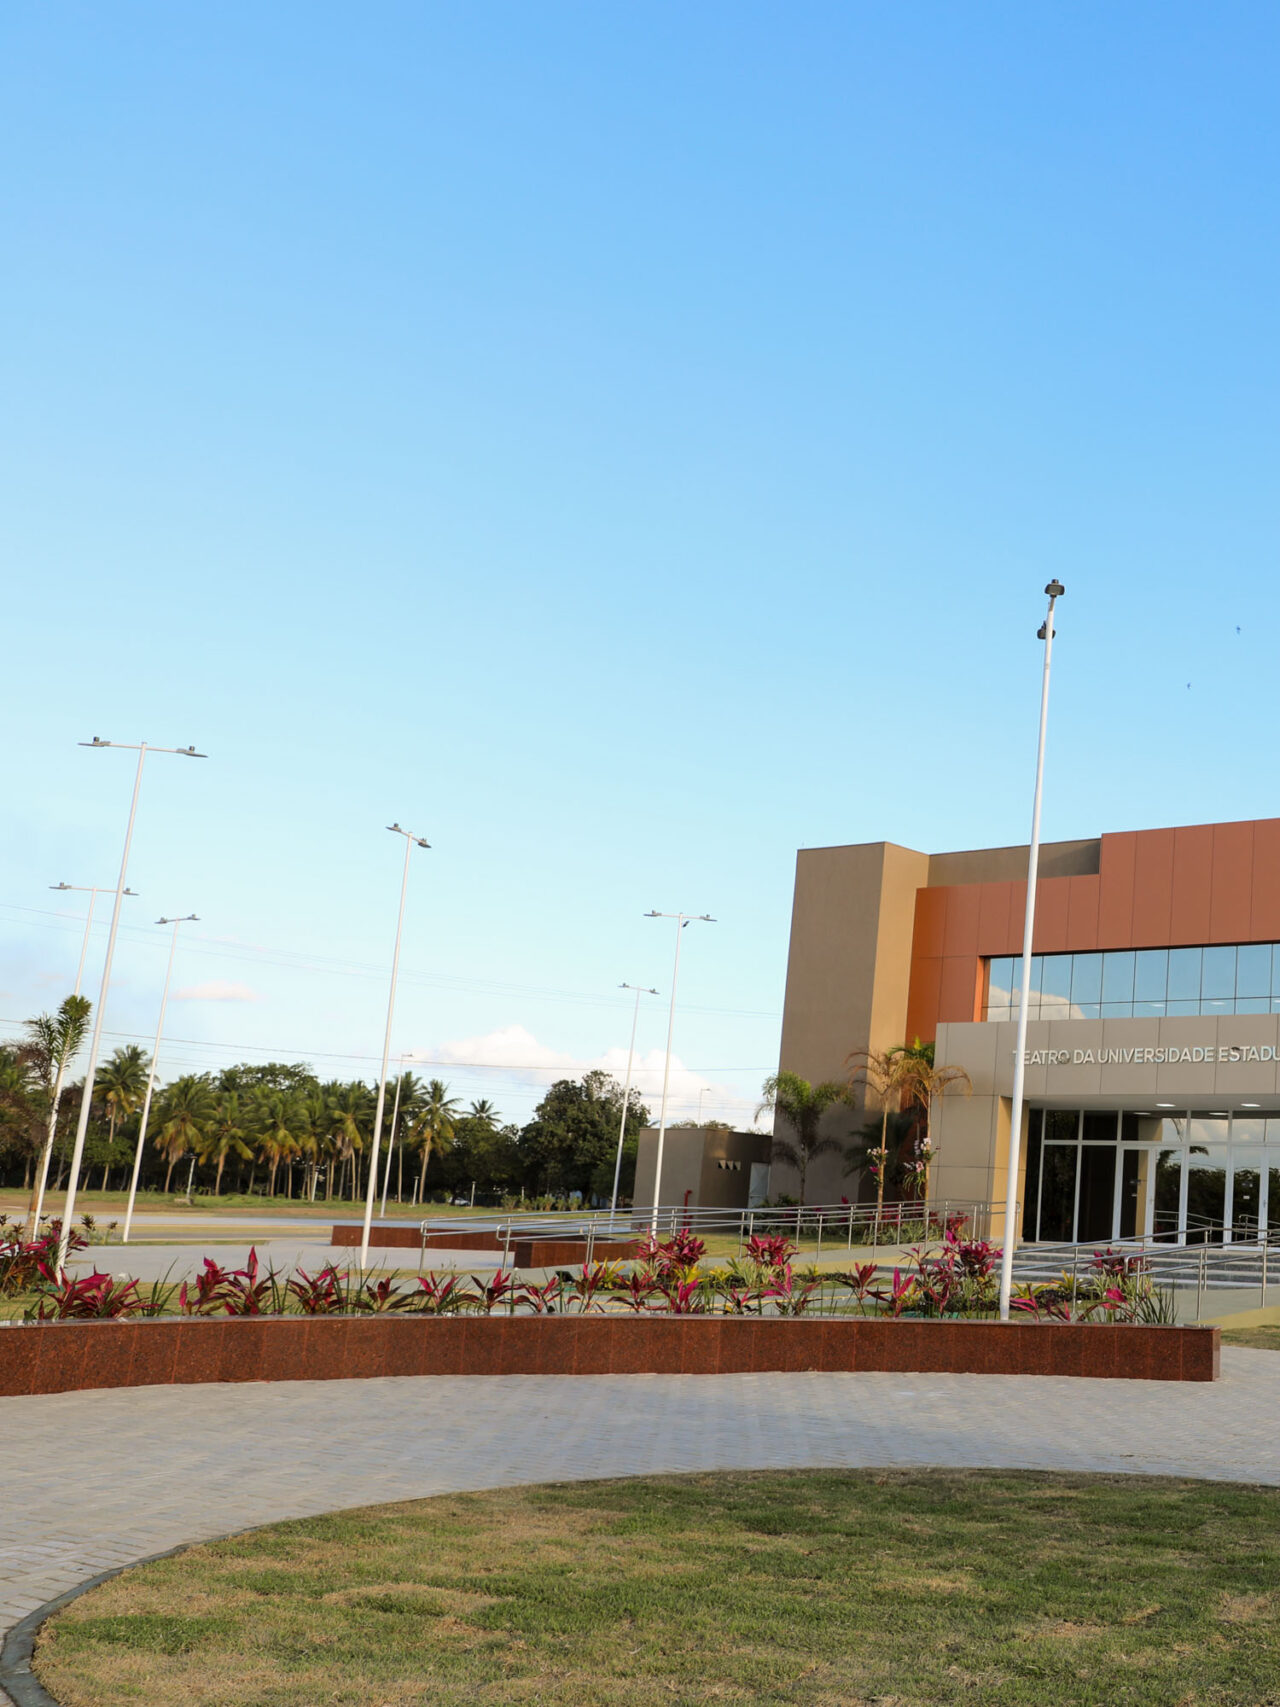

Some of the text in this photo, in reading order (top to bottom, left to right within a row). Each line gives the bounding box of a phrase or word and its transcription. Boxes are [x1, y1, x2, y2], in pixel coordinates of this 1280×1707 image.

[1012, 1050, 1070, 1065] EATRO
[1073, 1049, 1095, 1064] DA
[1098, 1047, 1214, 1063] UNIVERSIDADE
